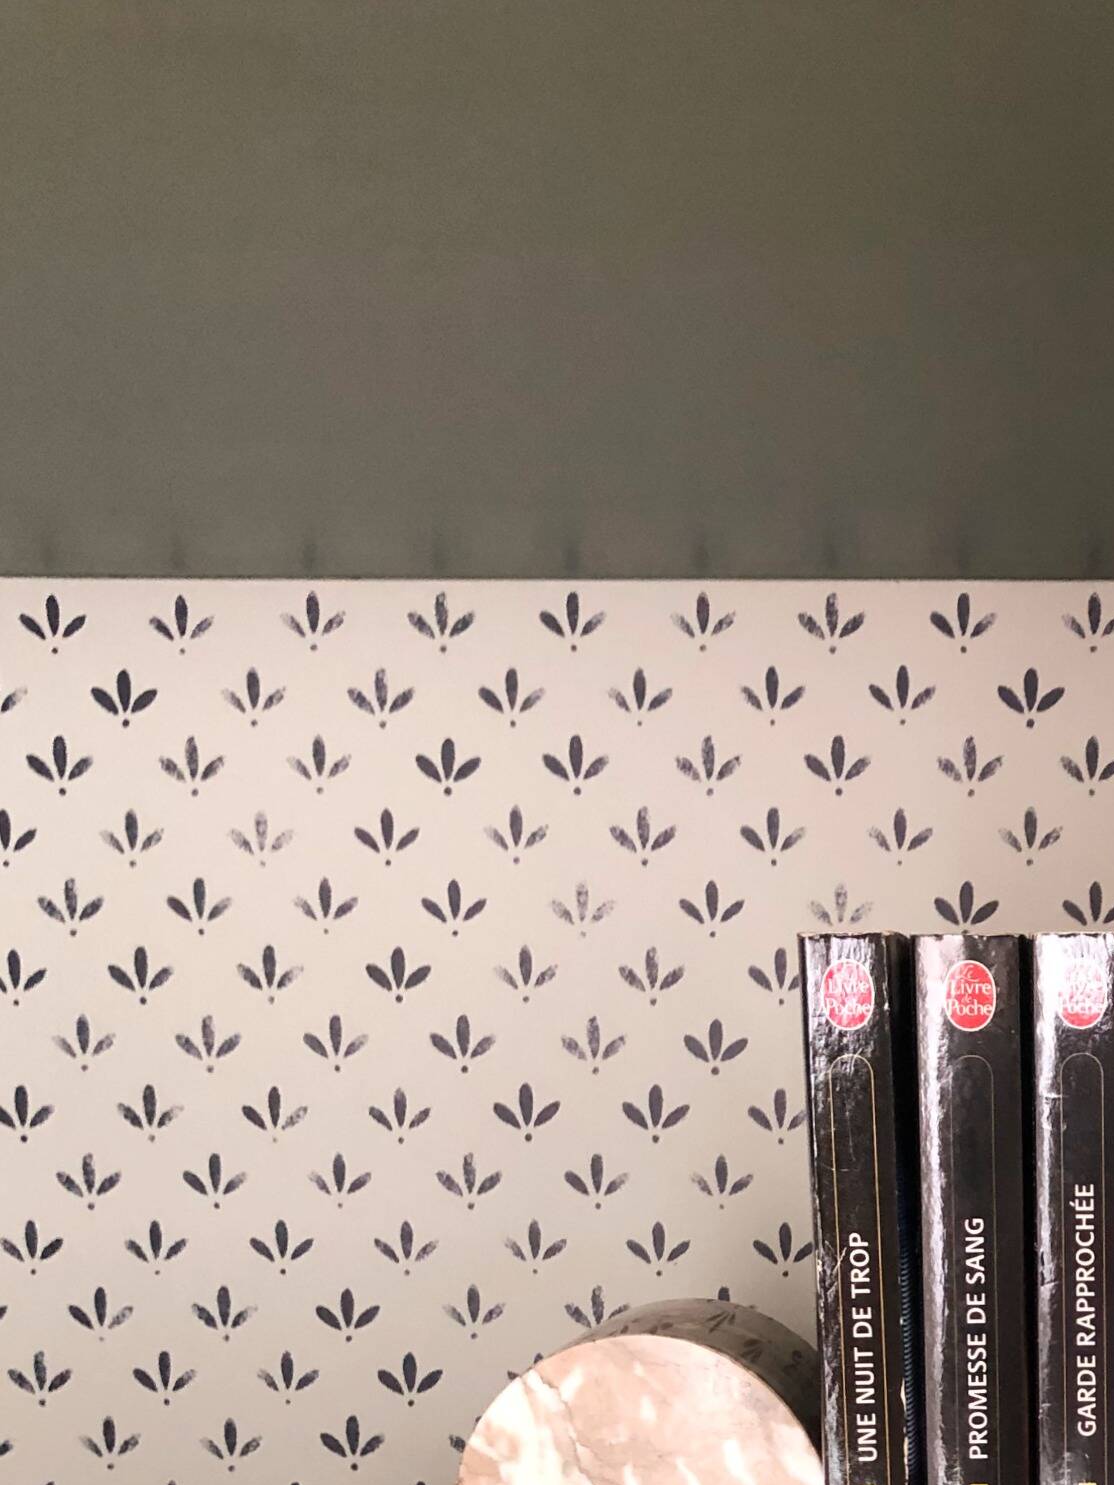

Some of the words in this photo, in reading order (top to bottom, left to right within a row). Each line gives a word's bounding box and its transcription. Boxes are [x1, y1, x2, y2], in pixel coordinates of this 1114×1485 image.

[947, 998, 993, 1016] Poche
[949, 980, 992, 995] Livre
[849, 1232, 871, 1299] TROP
[964, 1217, 986, 1285] SANG
[1070, 1183, 1096, 1347] RAPPROCHÉE
[852, 1307, 873, 1338] DE
[966, 1292, 986, 1324] DE
[854, 1347, 876, 1405] NUIT
[967, 1333, 989, 1460] PROMESSE
[1076, 1355, 1097, 1437] GARDE
[857, 1413, 878, 1462] UNE
